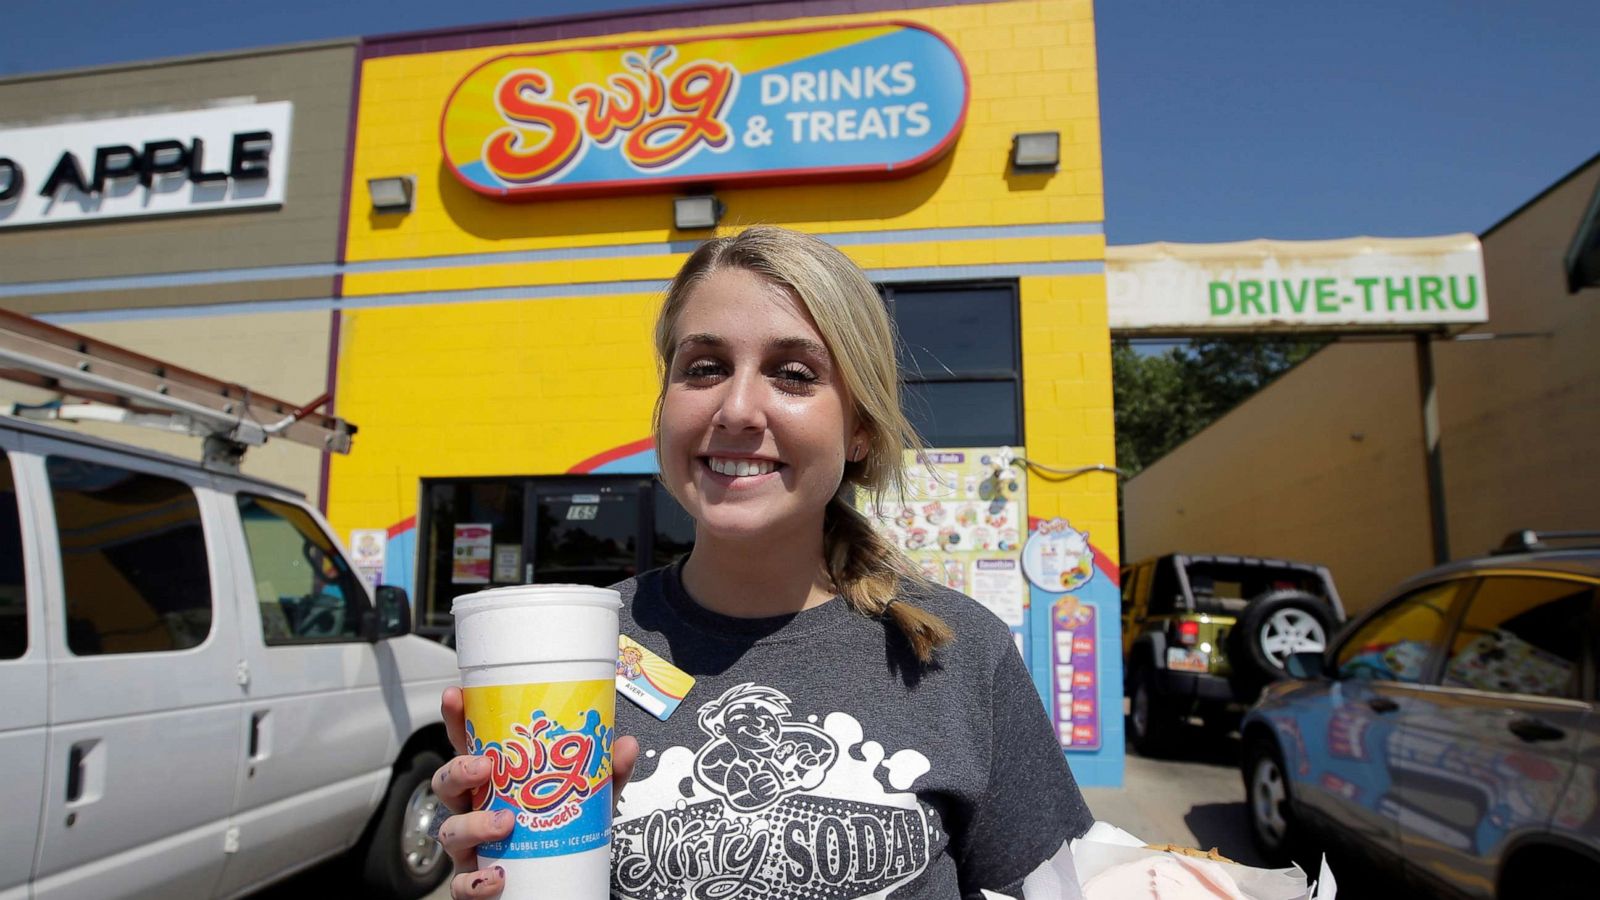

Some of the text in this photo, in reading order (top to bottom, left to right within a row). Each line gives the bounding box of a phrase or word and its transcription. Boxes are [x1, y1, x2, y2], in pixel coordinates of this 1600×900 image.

[760, 62, 916, 106] DRINKS
[486, 46, 729, 184] Swig
[742, 103, 931, 147] & TREATS
[39, 131, 272, 198] APPLE
[1208, 275, 1479, 316] DRIVE-THRU
[625, 683, 645, 697] AVERY
[467, 718, 592, 815] wig
[510, 842, 538, 851] BUBBLE
[541, 840, 559, 849] TEAS
[568, 836, 580, 846] ICE
[581, 832, 600, 844] CREAM
[784, 810, 916, 887] SODA
